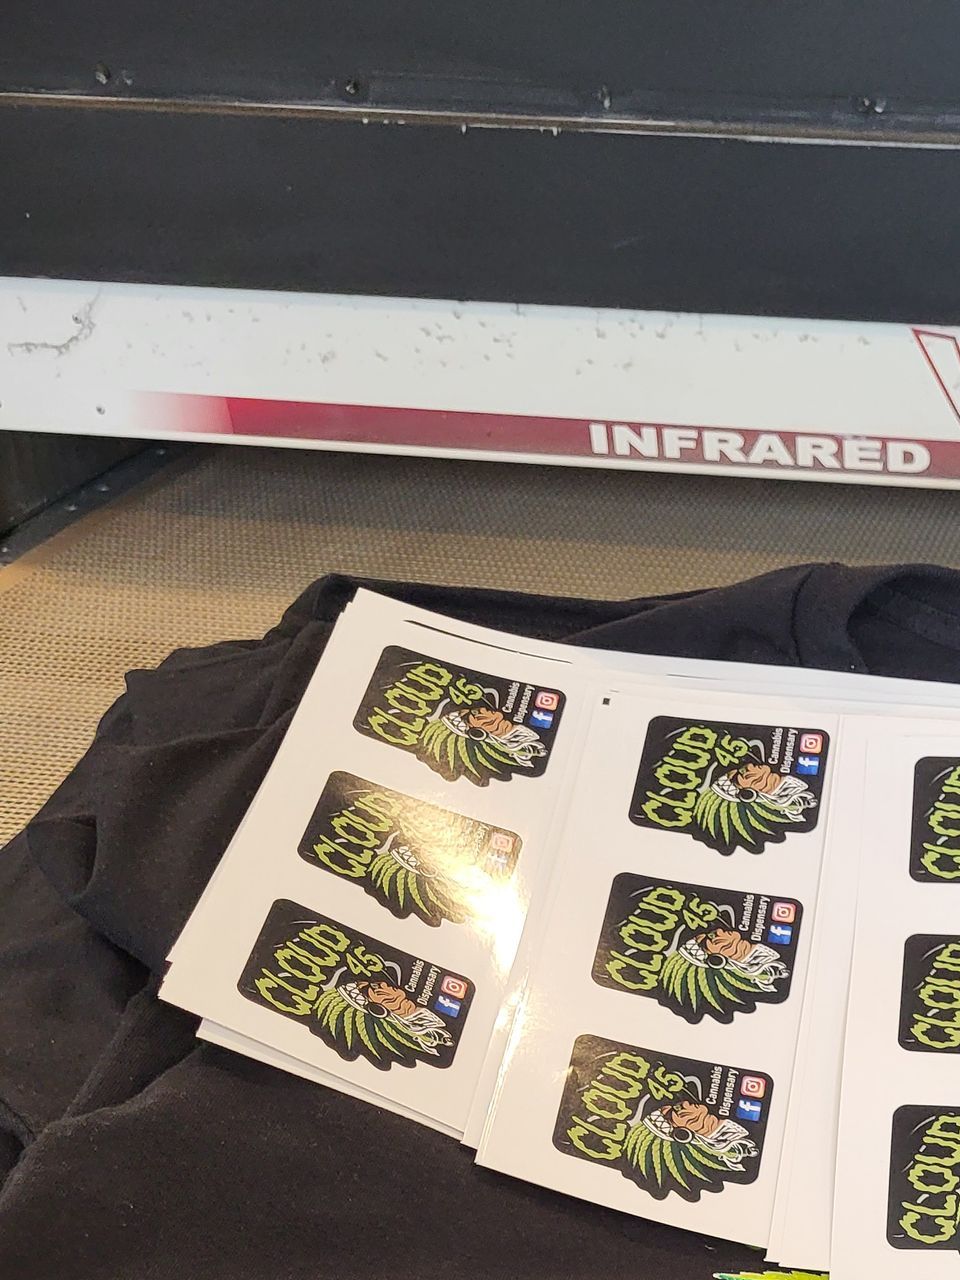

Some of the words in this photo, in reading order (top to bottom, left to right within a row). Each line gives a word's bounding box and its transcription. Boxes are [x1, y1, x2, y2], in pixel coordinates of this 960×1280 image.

[589, 421, 931, 474] INFRARED
[368, 663, 452, 746] CLOUD
[449, 678, 483, 705] 45
[502, 682, 520, 713] Cannabis
[513, 684, 535, 723] Dispensary
[715, 735, 749, 767] 45
[768, 728, 783, 764] Cannabis
[780, 729, 798, 773] Dispensary
[642, 727, 718, 827] CLOUD
[683, 898, 718, 930] 45
[738, 894, 754, 931] Cannabis
[751, 896, 770, 941] Dispensary
[605, 887, 685, 990] CLOUD
[255, 924, 350, 1016] CLOUD
[347, 946, 383, 977] 45
[404, 959, 425, 993] Cannabis
[417, 965, 441, 1006] Dispensary
[648, 1066, 684, 1100] 45
[706, 1066, 722, 1105] Cannabis
[719, 1068, 739, 1116] Dispensary
[567, 1053, 650, 1160] CLOUD
